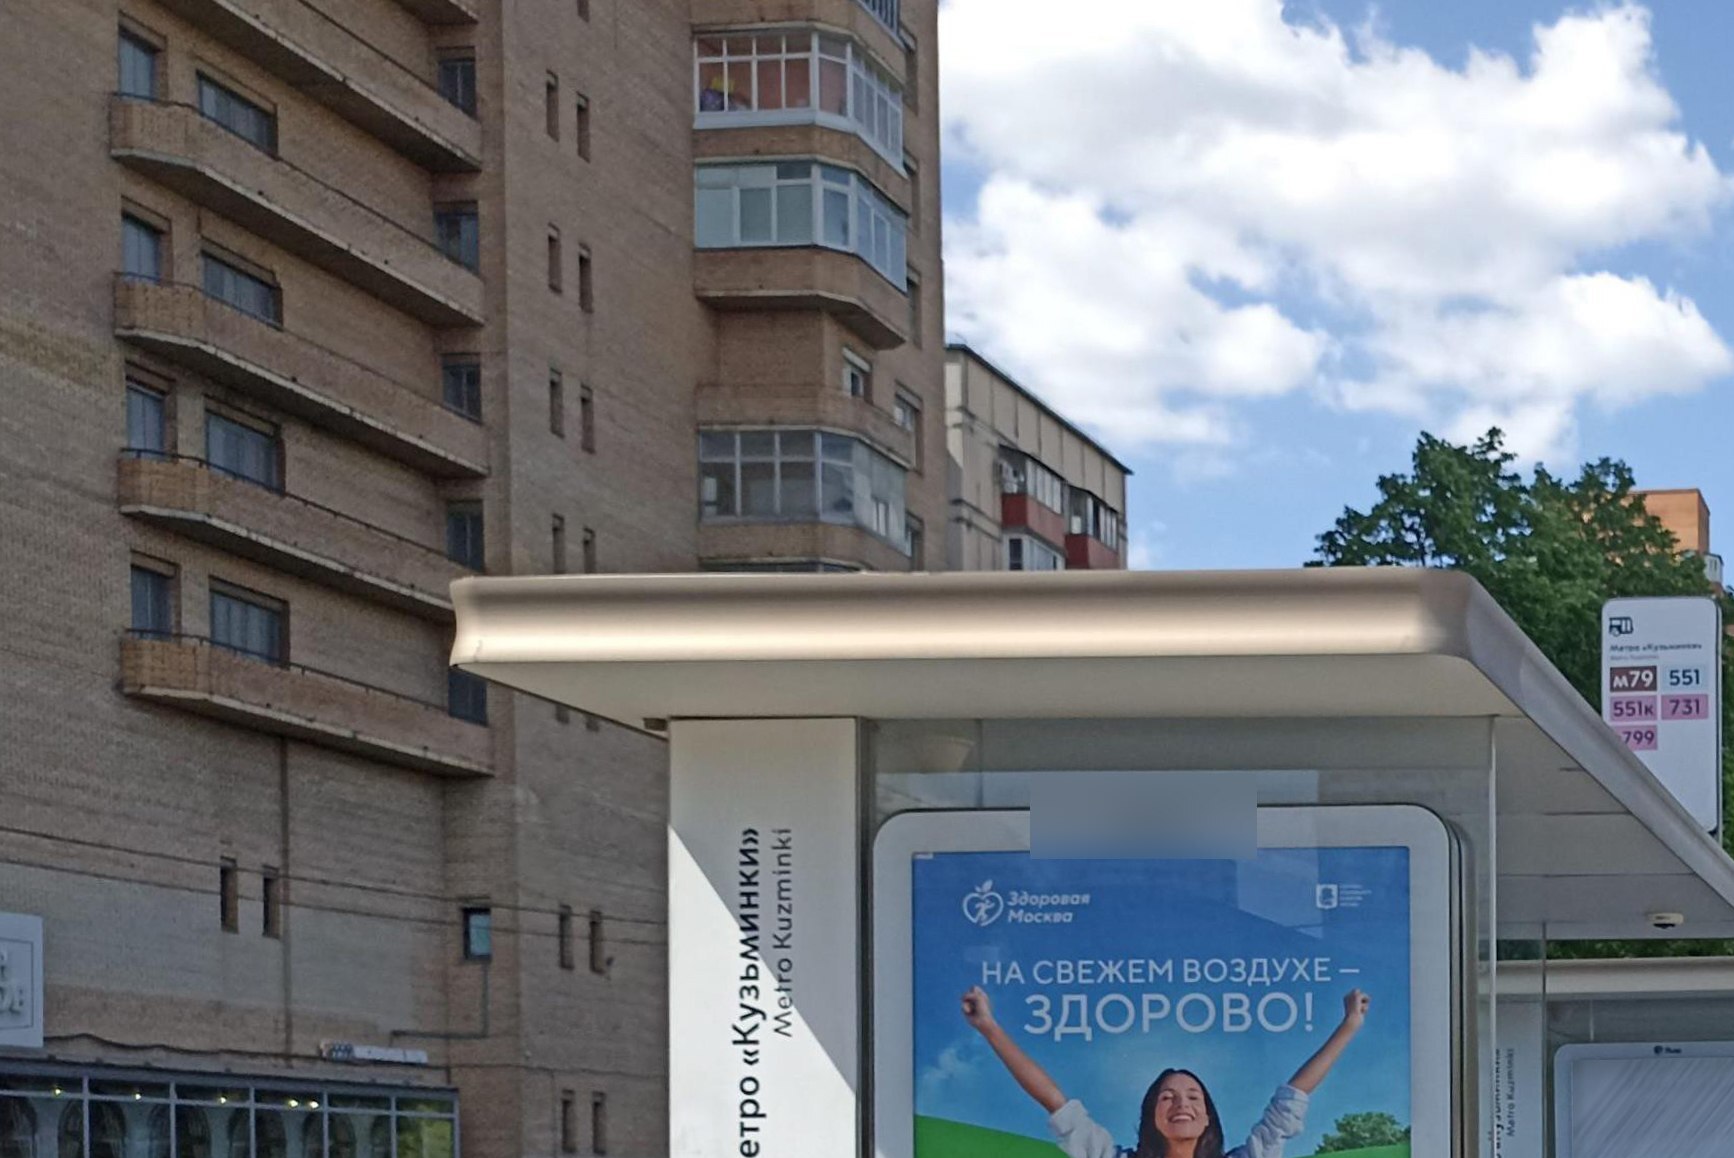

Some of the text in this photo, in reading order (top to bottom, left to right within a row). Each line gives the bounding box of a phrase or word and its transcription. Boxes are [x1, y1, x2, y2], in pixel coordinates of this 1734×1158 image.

[1669, 669, 1700, 686] 551
[1613, 700, 1654, 717] 551к
[1669, 699, 1700, 715] 731
[1007, 890, 1091, 908] Здоровая
[1007, 909, 1073, 923] Москва
[771, 828, 793, 1037] Metro Kuzminki
[731, 828, 767, 1066] «Кузьминки»
[981, 960, 1025, 985] НА
[1032, 958, 1174, 985] СВЕЖЕМ
[1183, 957, 1332, 987] ВОЗДУХЕ
[1024, 991, 1314, 1041] ЗДОРОВО!
